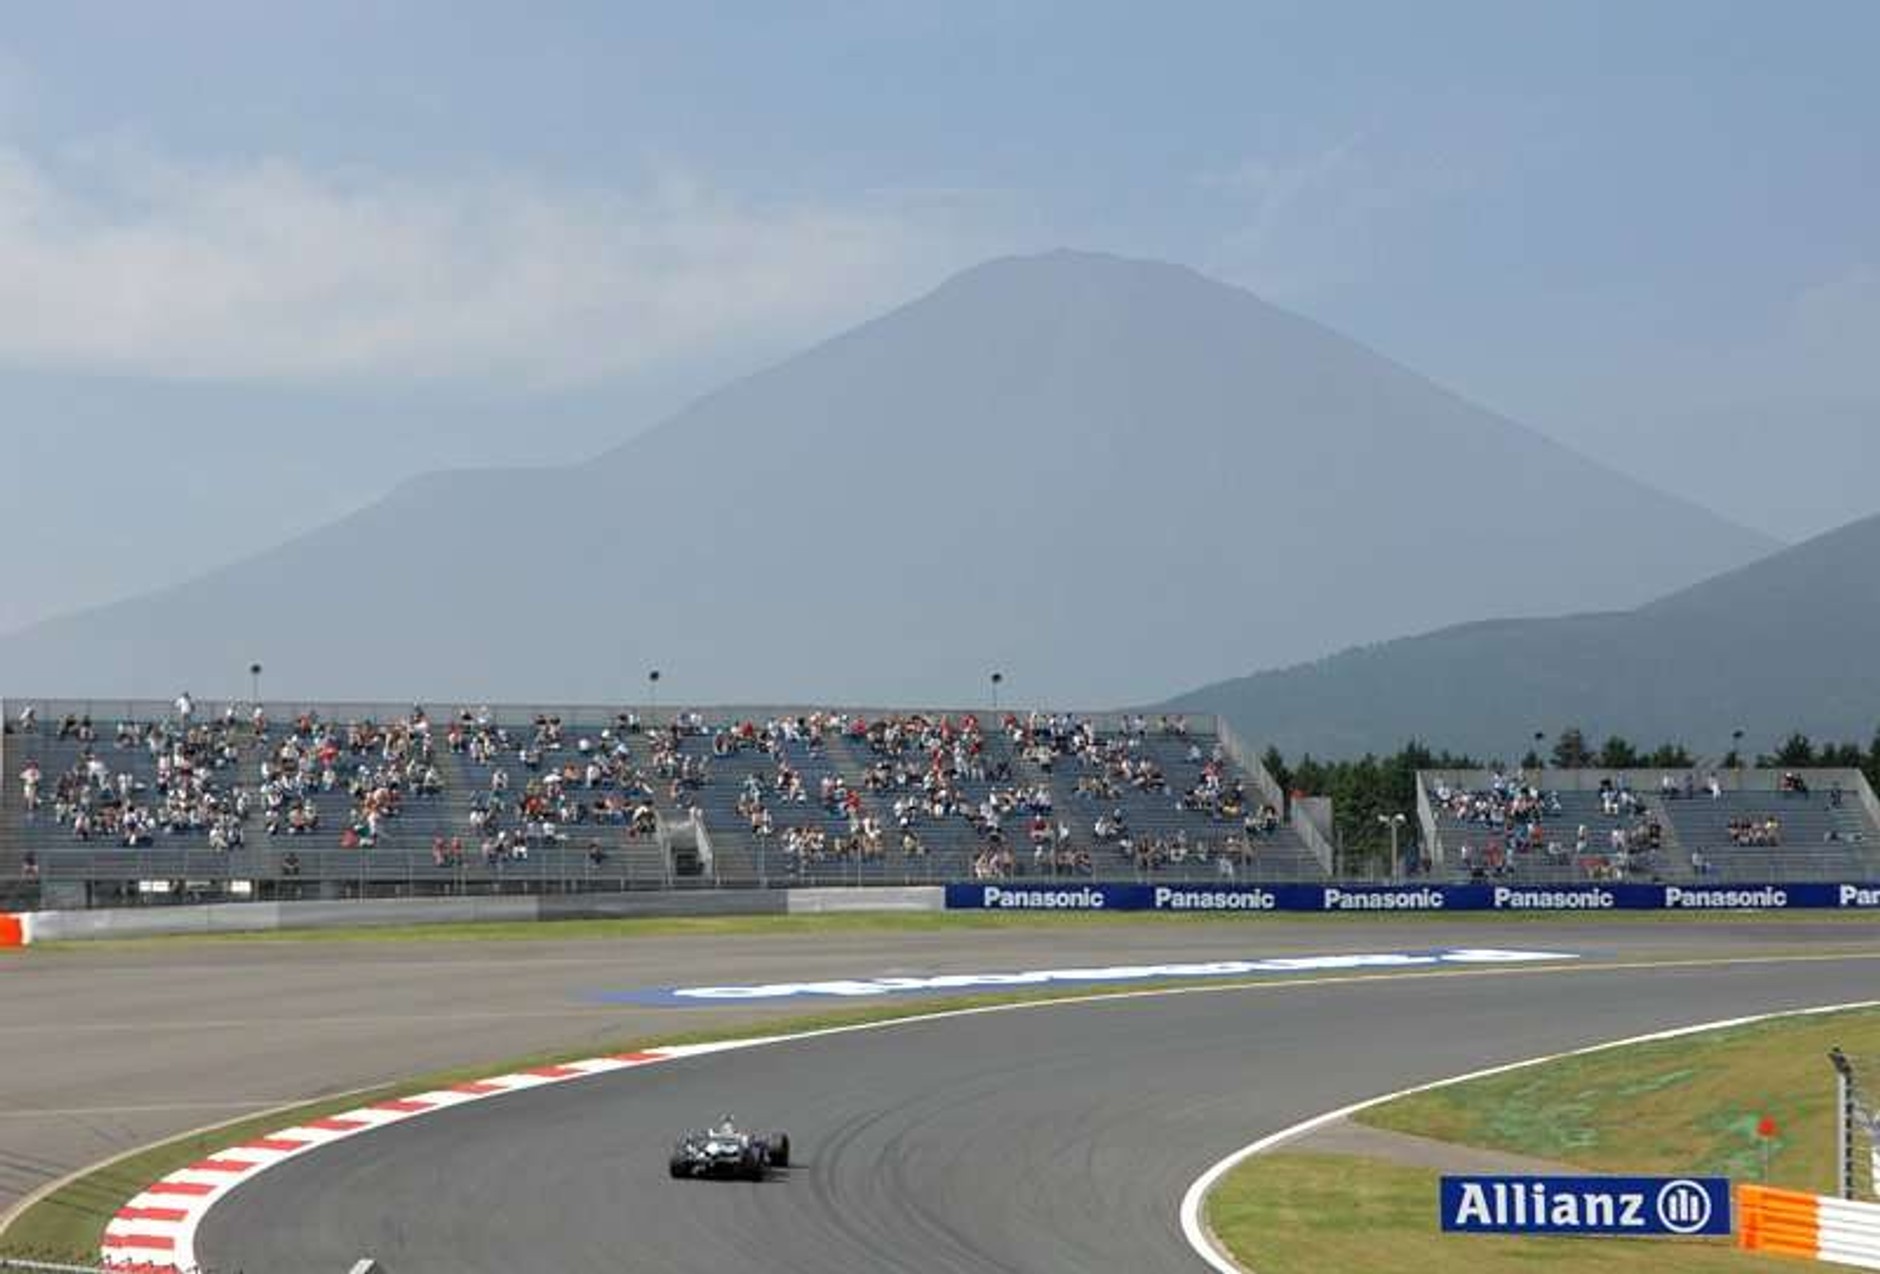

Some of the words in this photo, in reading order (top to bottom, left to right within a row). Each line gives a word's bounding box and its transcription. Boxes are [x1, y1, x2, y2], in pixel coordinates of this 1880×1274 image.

[984, 886, 1104, 908] Panasonic
[1155, 887, 1275, 909] Panasonic
[1324, 888, 1443, 909] Panasonic
[1494, 886, 1613, 908] Panasonic
[1665, 886, 1786, 907] Panasonic
[1455, 1182, 1645, 1226] Allianz
